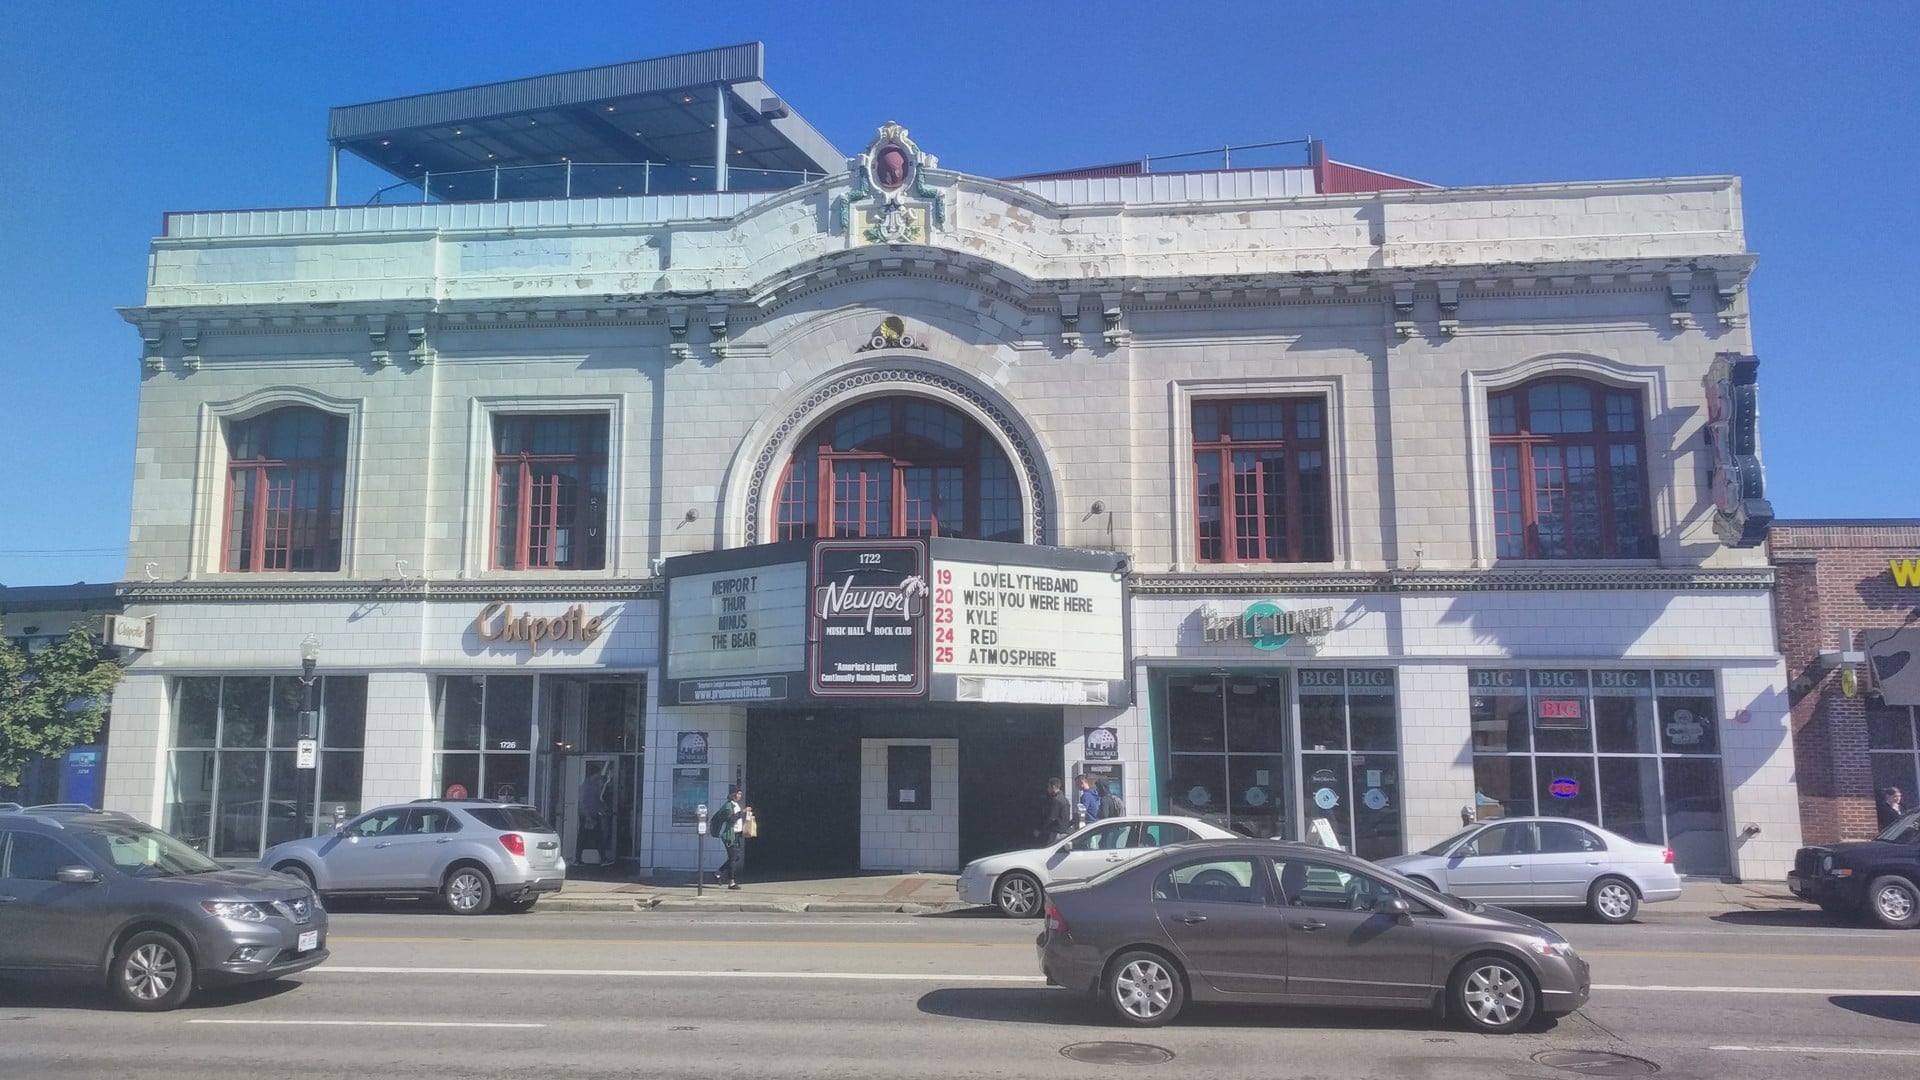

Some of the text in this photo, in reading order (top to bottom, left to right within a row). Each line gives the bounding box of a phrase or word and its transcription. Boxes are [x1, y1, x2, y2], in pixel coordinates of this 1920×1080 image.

[859, 553, 881, 565] 1722
[936, 569, 952, 585] 19
[711, 576, 758, 596] NEWPORT
[721, 595, 747, 613] THUR
[822, 575, 929, 633] Newport
[935, 588, 1093, 613] 20 WISH YOU WERE HERE
[718, 613, 748, 631] MINUS
[935, 608, 998, 626] 23 KYLE
[1203, 606, 1334, 642] LITTLE DONUT
[476, 600, 604, 657] Chipotle
[826, 626, 912, 636] MUSIC HALL ROCK CLUB
[935, 627, 998, 645] 24 RED
[711, 631, 757, 650] THE BEAR
[935, 647, 1057, 667] 25 ATMOSPHERE
[871, 662, 898, 673] Longest
[881, 673, 897, 682] Rock
[1301, 670, 1337, 686] BIG
[1350, 670, 1386, 686] BIG
[1477, 671, 1513, 686] BIG
[1538, 671, 1576, 687] BIG
[1600, 671, 1638, 687] BIG
[1663, 671, 1701, 687] BIG
[1541, 701, 1579, 717] BIG
